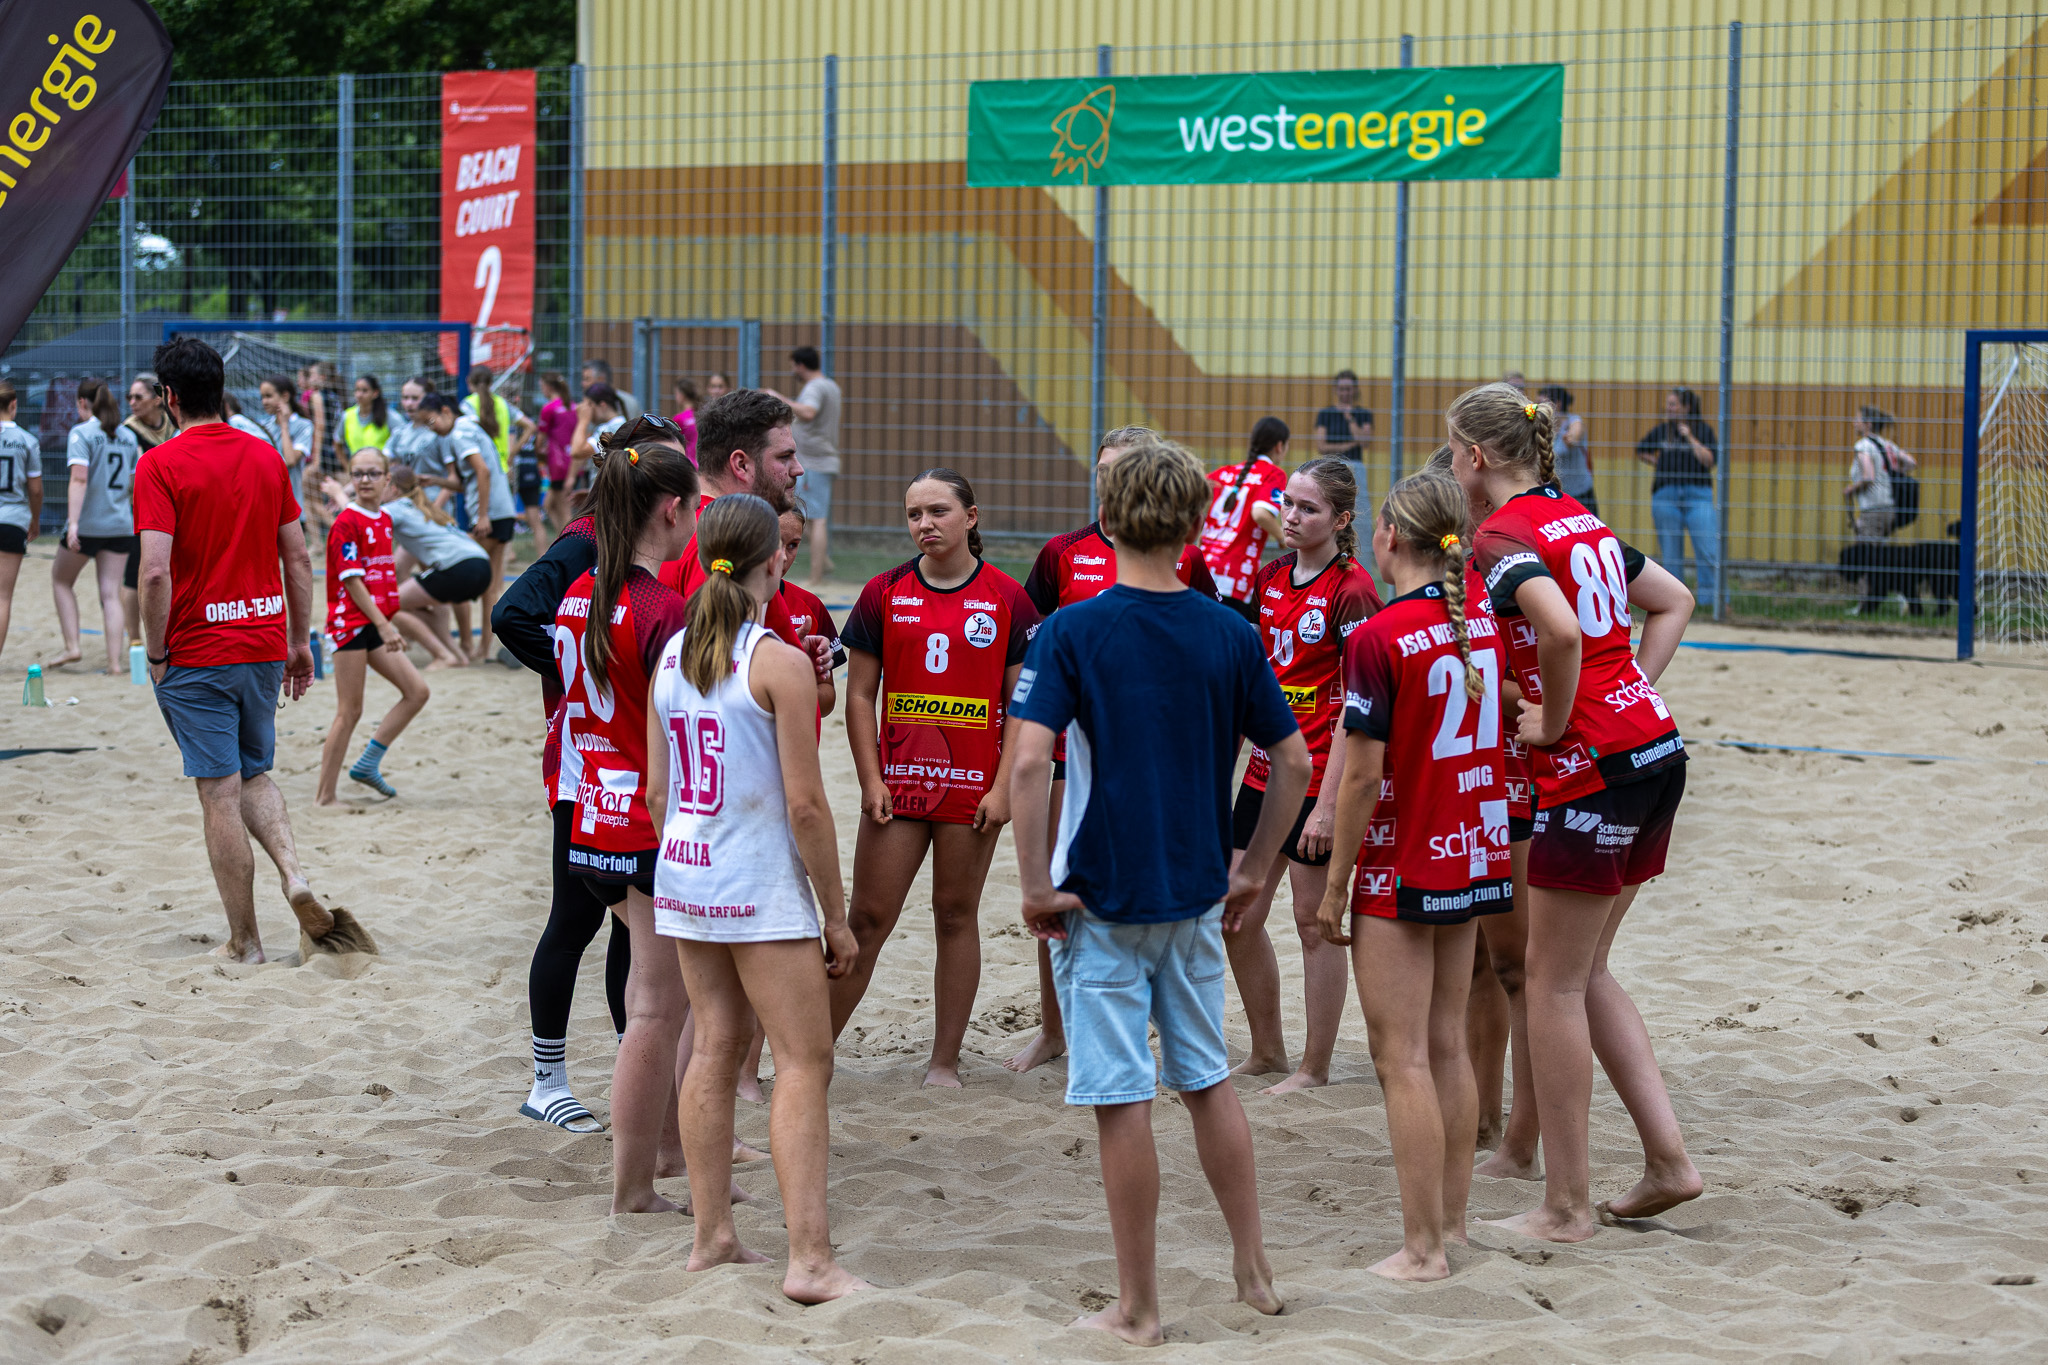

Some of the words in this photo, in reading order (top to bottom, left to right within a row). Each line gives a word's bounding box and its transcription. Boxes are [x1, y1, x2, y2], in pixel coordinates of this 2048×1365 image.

[0, 14, 116, 209] nergie
[1179, 95, 1487, 161] westenergie
[455, 144, 521, 192] BEACH
[455, 190, 520, 237] COURT
[470, 245, 502, 366] 2
[108, 453, 123, 489] 2
[1560, 514, 1607, 533] WESTFA
[1074, 572, 1103, 582] Kempa
[1570, 537, 1631, 637] 80
[205, 595, 283, 622] ORGA-TEAM
[892, 614, 921, 624] Kempa
[980, 626, 992, 636] JSG
[1397, 629, 1432, 657] JSG
[925, 632, 950, 674] 8
[894, 698, 987, 719] SCHOLDRA
[1428, 647, 1500, 760] 27
[670, 713, 725, 817] 16
[884, 763, 984, 782] HERWEG
[914, 756, 951, 764] UHREN
[599, 854, 638, 875] Erfolg!
[664, 837, 712, 867] MALIA
[1474, 886, 1501, 903] zum
[688, 903, 706, 917] ZUM
[709, 904, 756, 918] ERFOLG!
